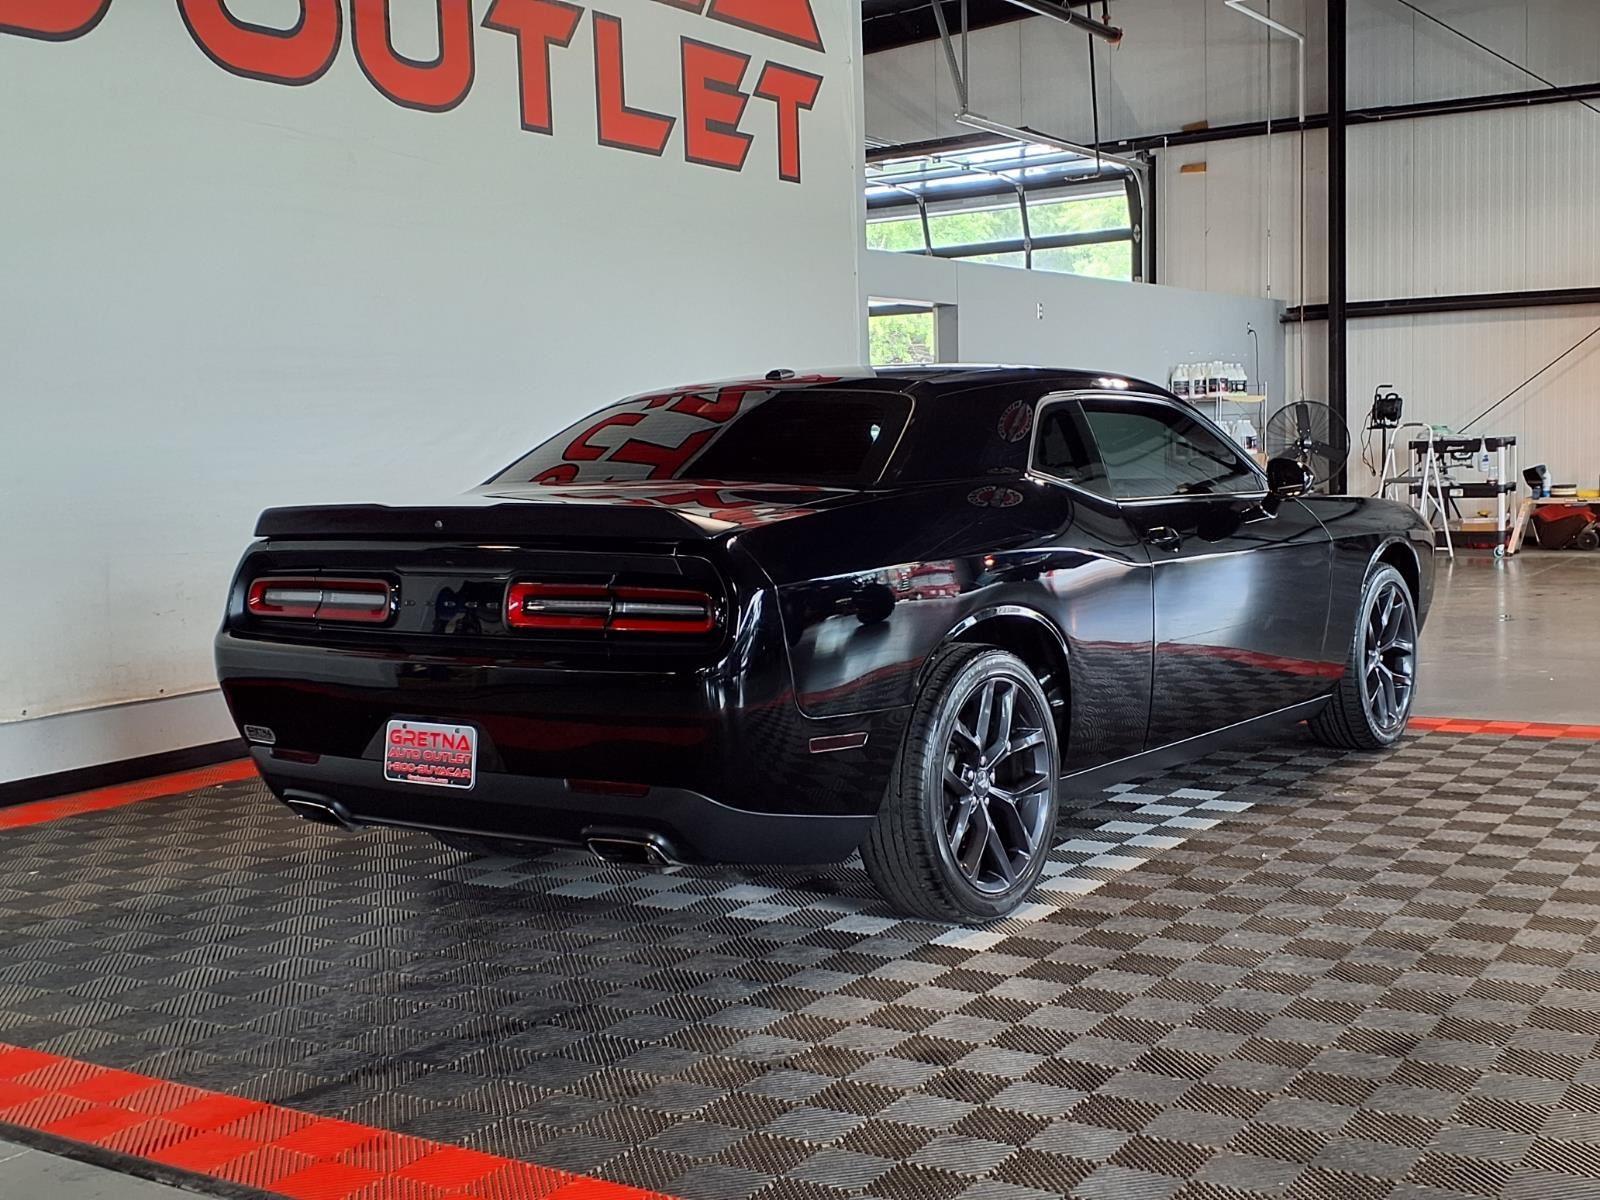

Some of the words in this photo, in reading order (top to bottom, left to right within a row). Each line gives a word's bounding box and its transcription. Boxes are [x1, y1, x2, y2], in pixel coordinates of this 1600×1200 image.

[390, 729, 471, 751] GRETNA
[388, 747, 420, 759] AUTO
[423, 750, 472, 764] OUTLET
